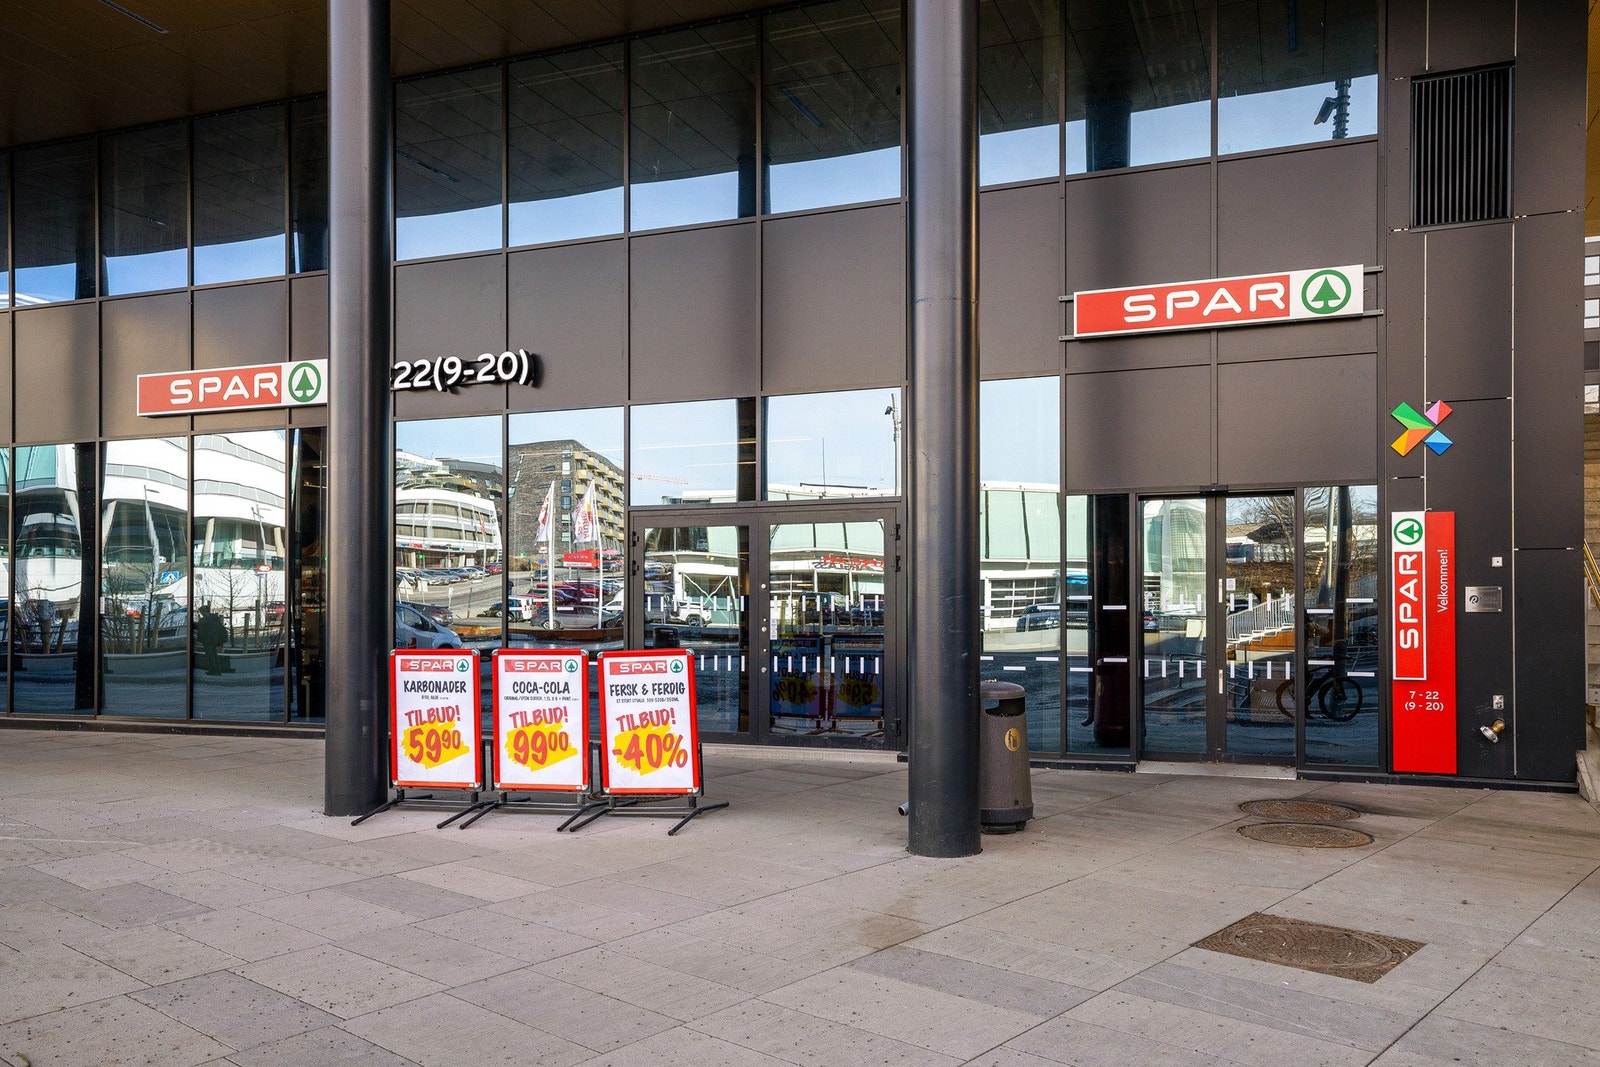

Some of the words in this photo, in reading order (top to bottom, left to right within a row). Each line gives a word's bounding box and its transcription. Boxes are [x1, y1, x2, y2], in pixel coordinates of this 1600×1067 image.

[1123, 281, 1286, 323] SPAR
[390, 349, 529, 392] 22(9-20)
[169, 371, 279, 405] SPAR
[1437, 549, 1448, 613] Velkommen!
[1398, 553, 1419, 650] SPAR
[409, 660, 453, 670] SPAR
[514, 661, 561, 671] SPAR
[619, 662, 667, 673] SPAR
[403, 680, 467, 694] KARBONADER
[512, 681, 571, 695] COCA-COLA
[609, 683, 639, 697] FERSK
[641, 683, 649, 696] &
[651, 681, 686, 696] FERDIG
[1409, 691, 1416, 700] 7
[1425, 691, 1440, 700] 22
[404, 704, 461, 727] TILBUD!
[508, 705, 569, 729] TILBUD!
[1404, 701, 1416, 712] (9
[1426, 701, 1445, 712] 20)
[615, 707, 677, 733] TILBUD!
[611, 732, 689, 771] -40%
